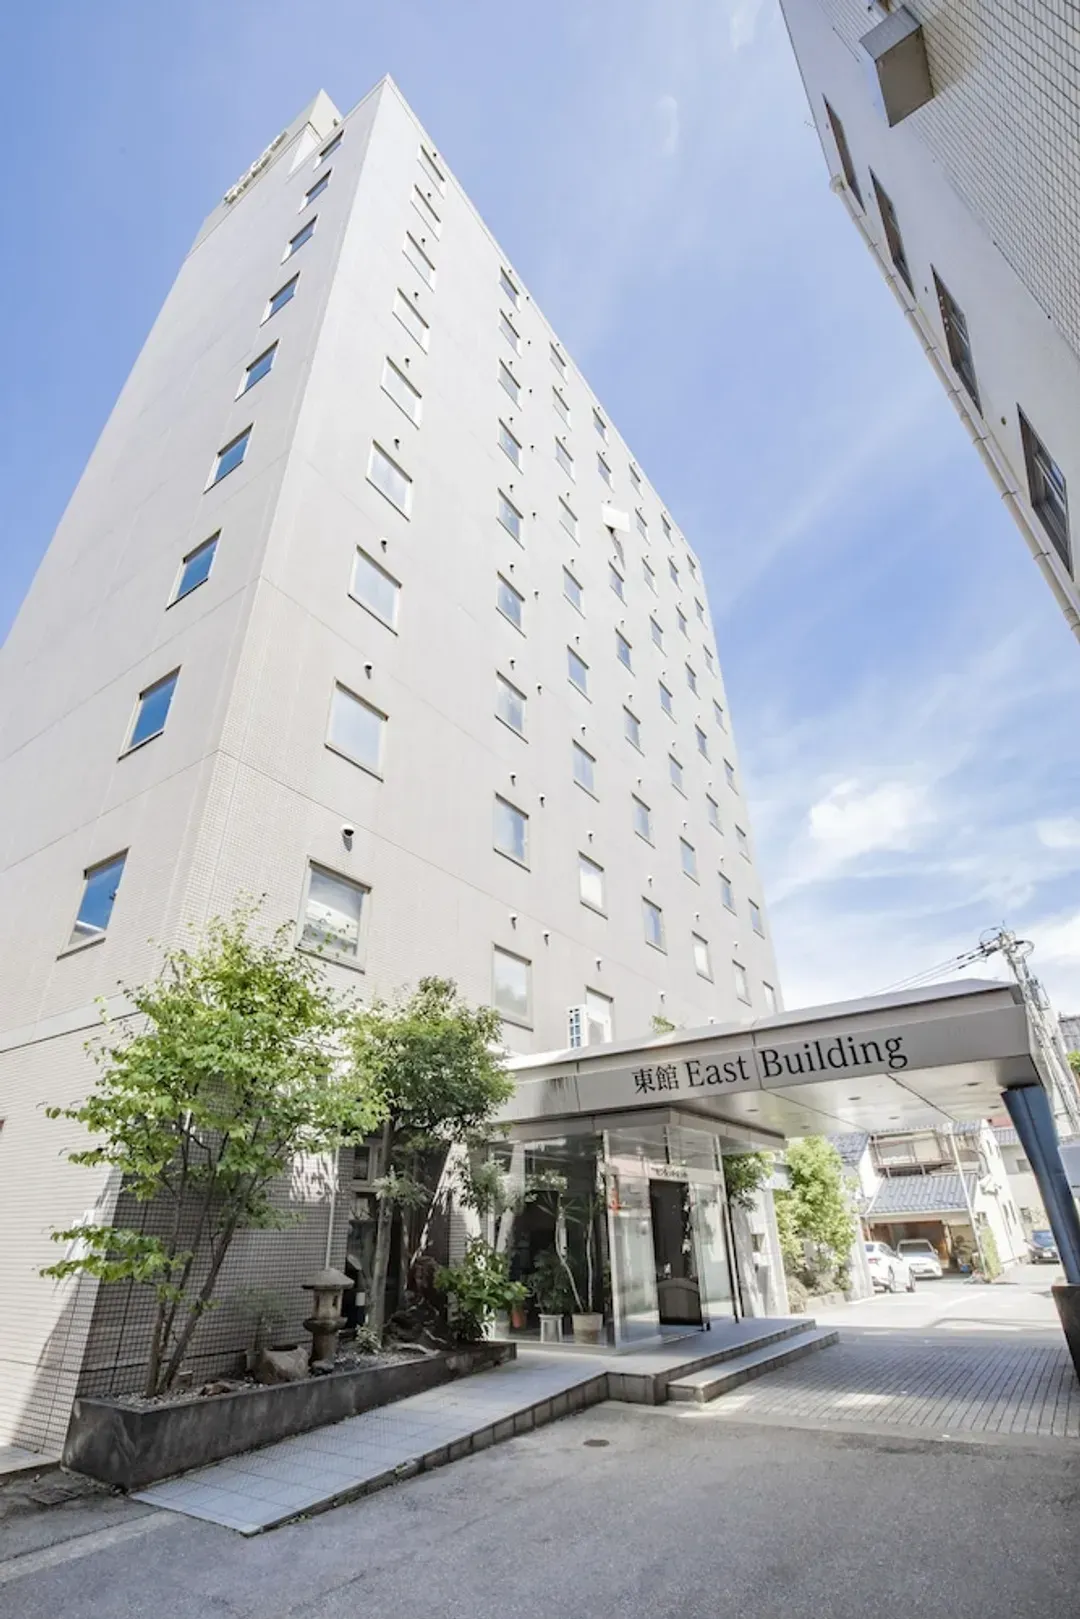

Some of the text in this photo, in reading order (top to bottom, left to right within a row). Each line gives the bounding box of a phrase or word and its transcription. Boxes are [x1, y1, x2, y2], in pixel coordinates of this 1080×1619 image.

[631, 1036, 908, 1094] 東館 East Building
